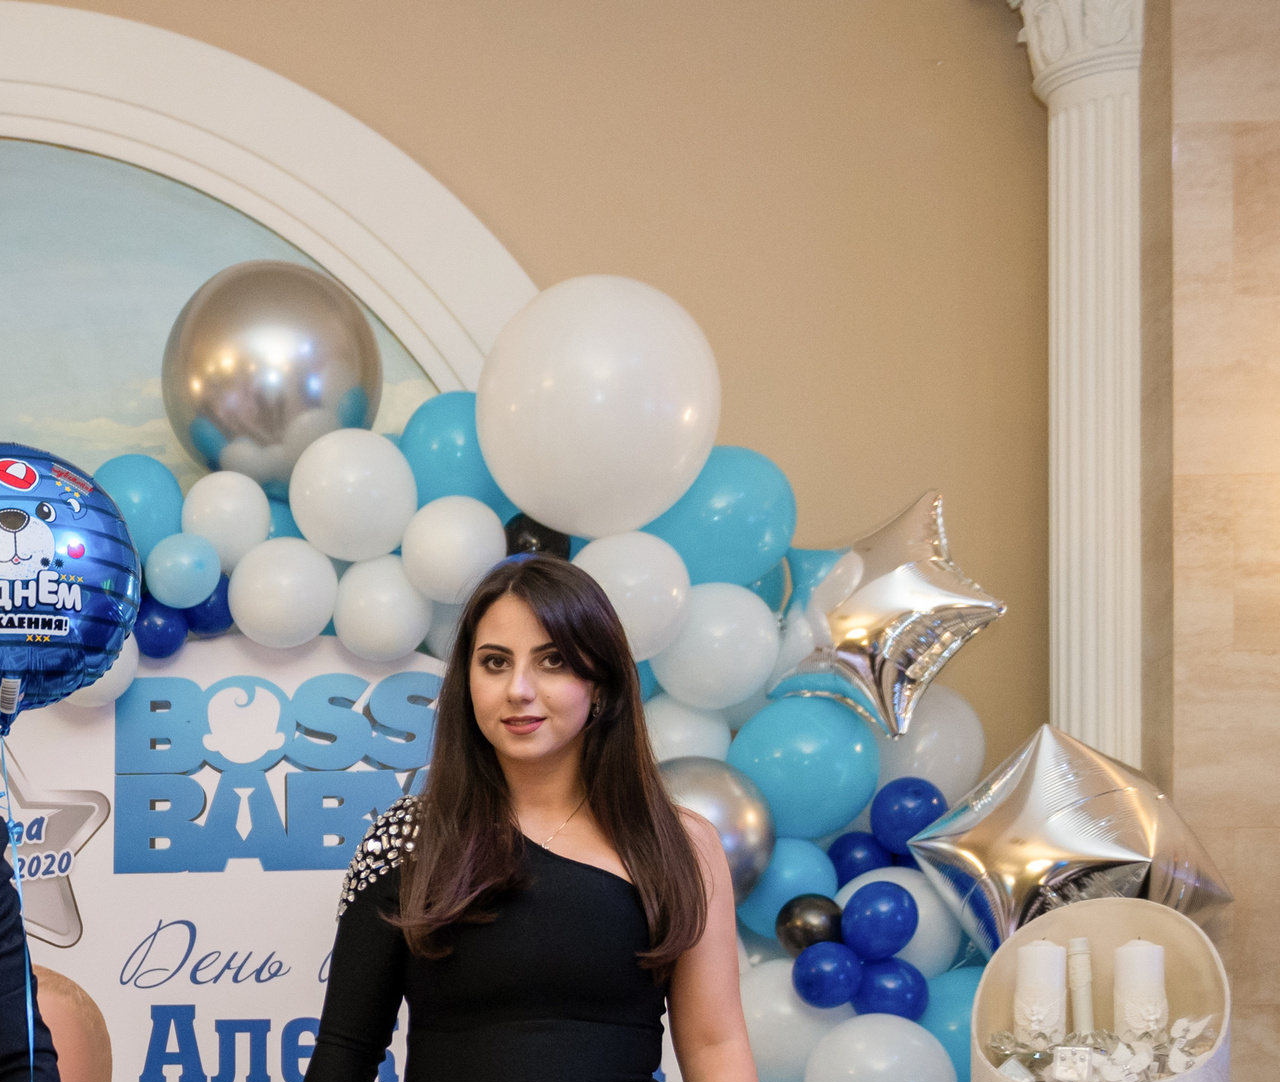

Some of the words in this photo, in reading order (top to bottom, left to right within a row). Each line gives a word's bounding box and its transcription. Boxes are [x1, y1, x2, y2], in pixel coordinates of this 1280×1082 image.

[114, 671, 447, 775] BOSS
[114, 768, 428, 874] BAB
[120, 918, 291, 990] День
